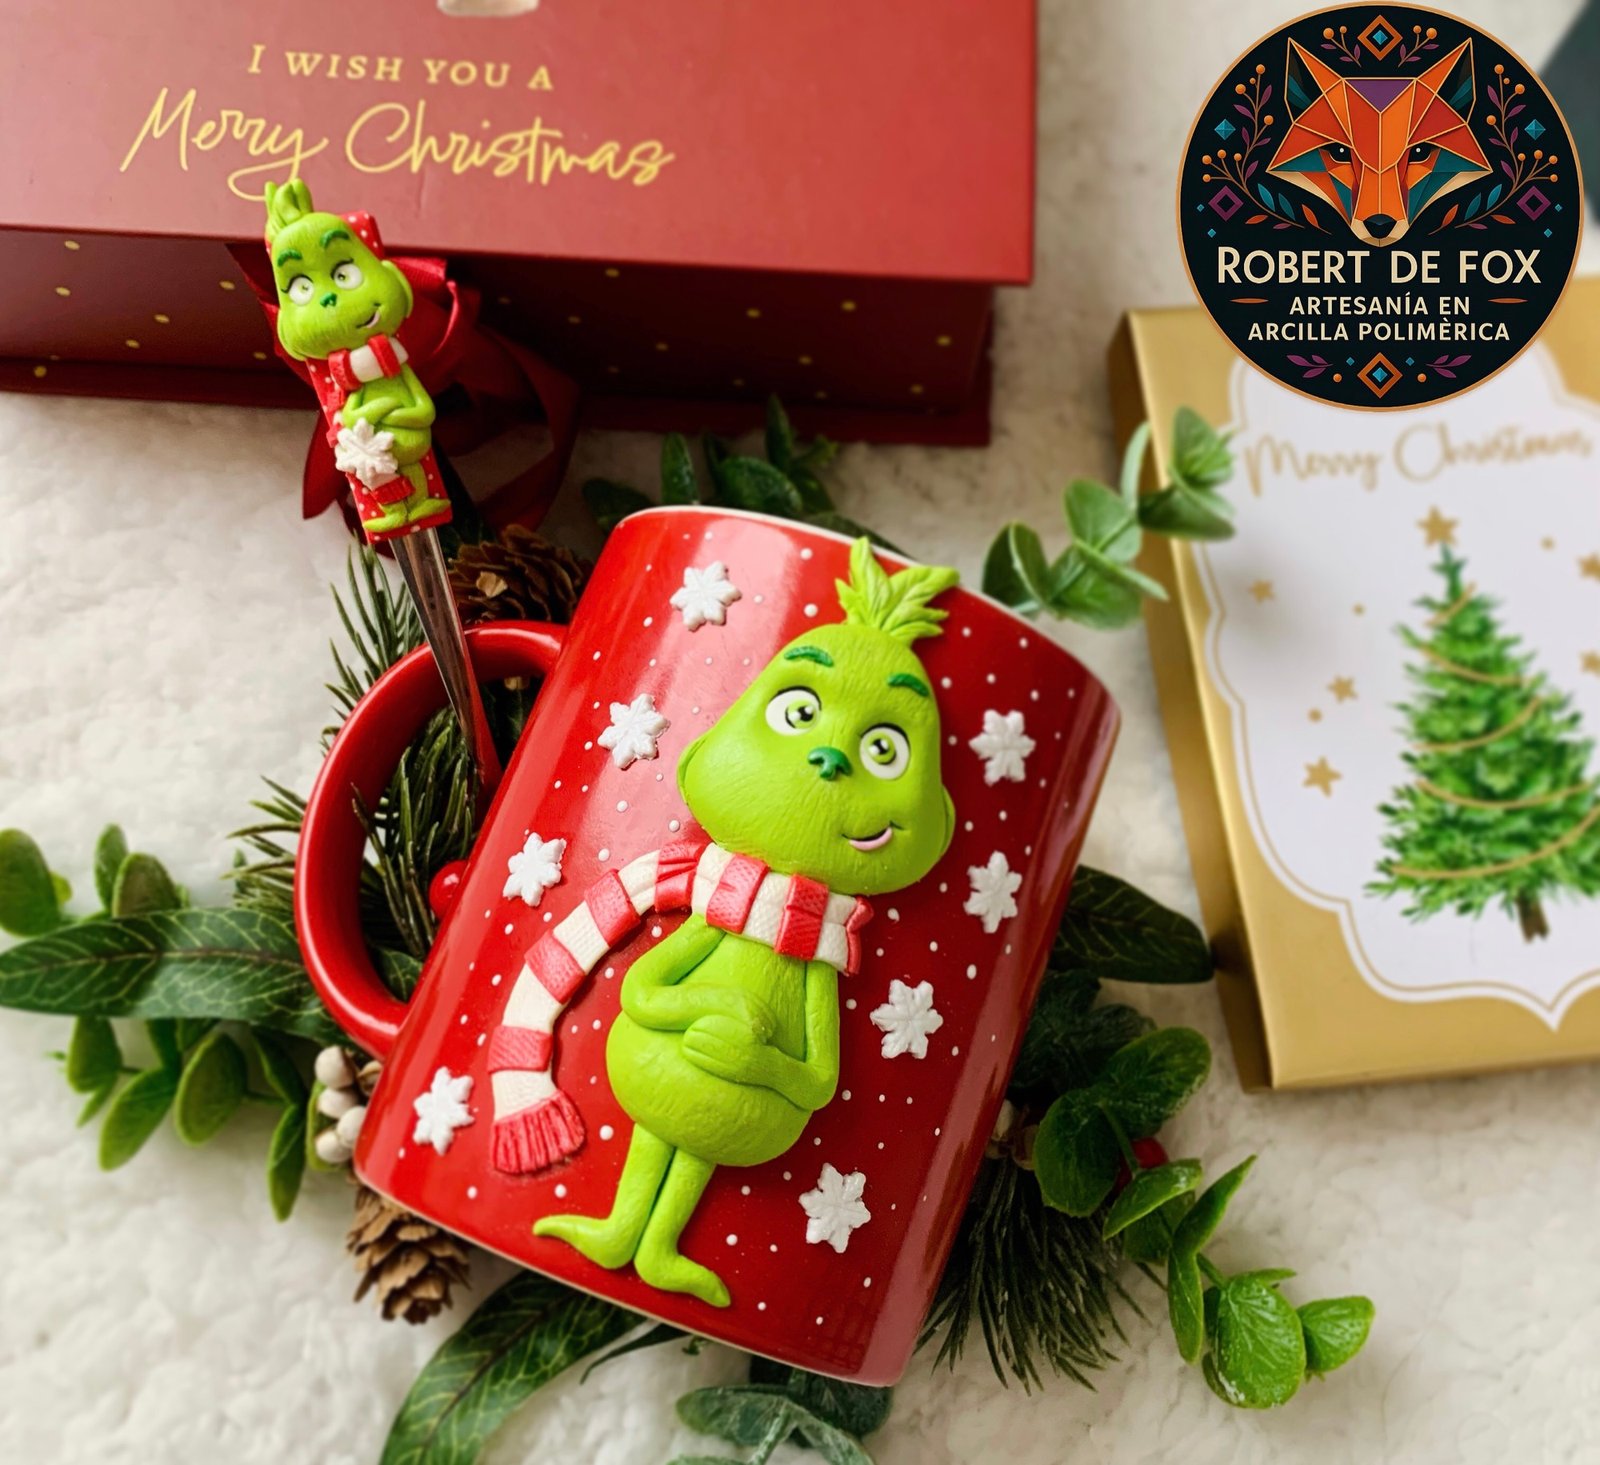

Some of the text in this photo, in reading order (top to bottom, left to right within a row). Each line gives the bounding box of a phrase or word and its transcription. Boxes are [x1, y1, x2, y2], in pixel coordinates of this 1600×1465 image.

[247, 44, 554, 90] I WISH YOU A
[119, 87, 676, 201] Merry Christmas
[1244, 433, 1384, 499] Merry
